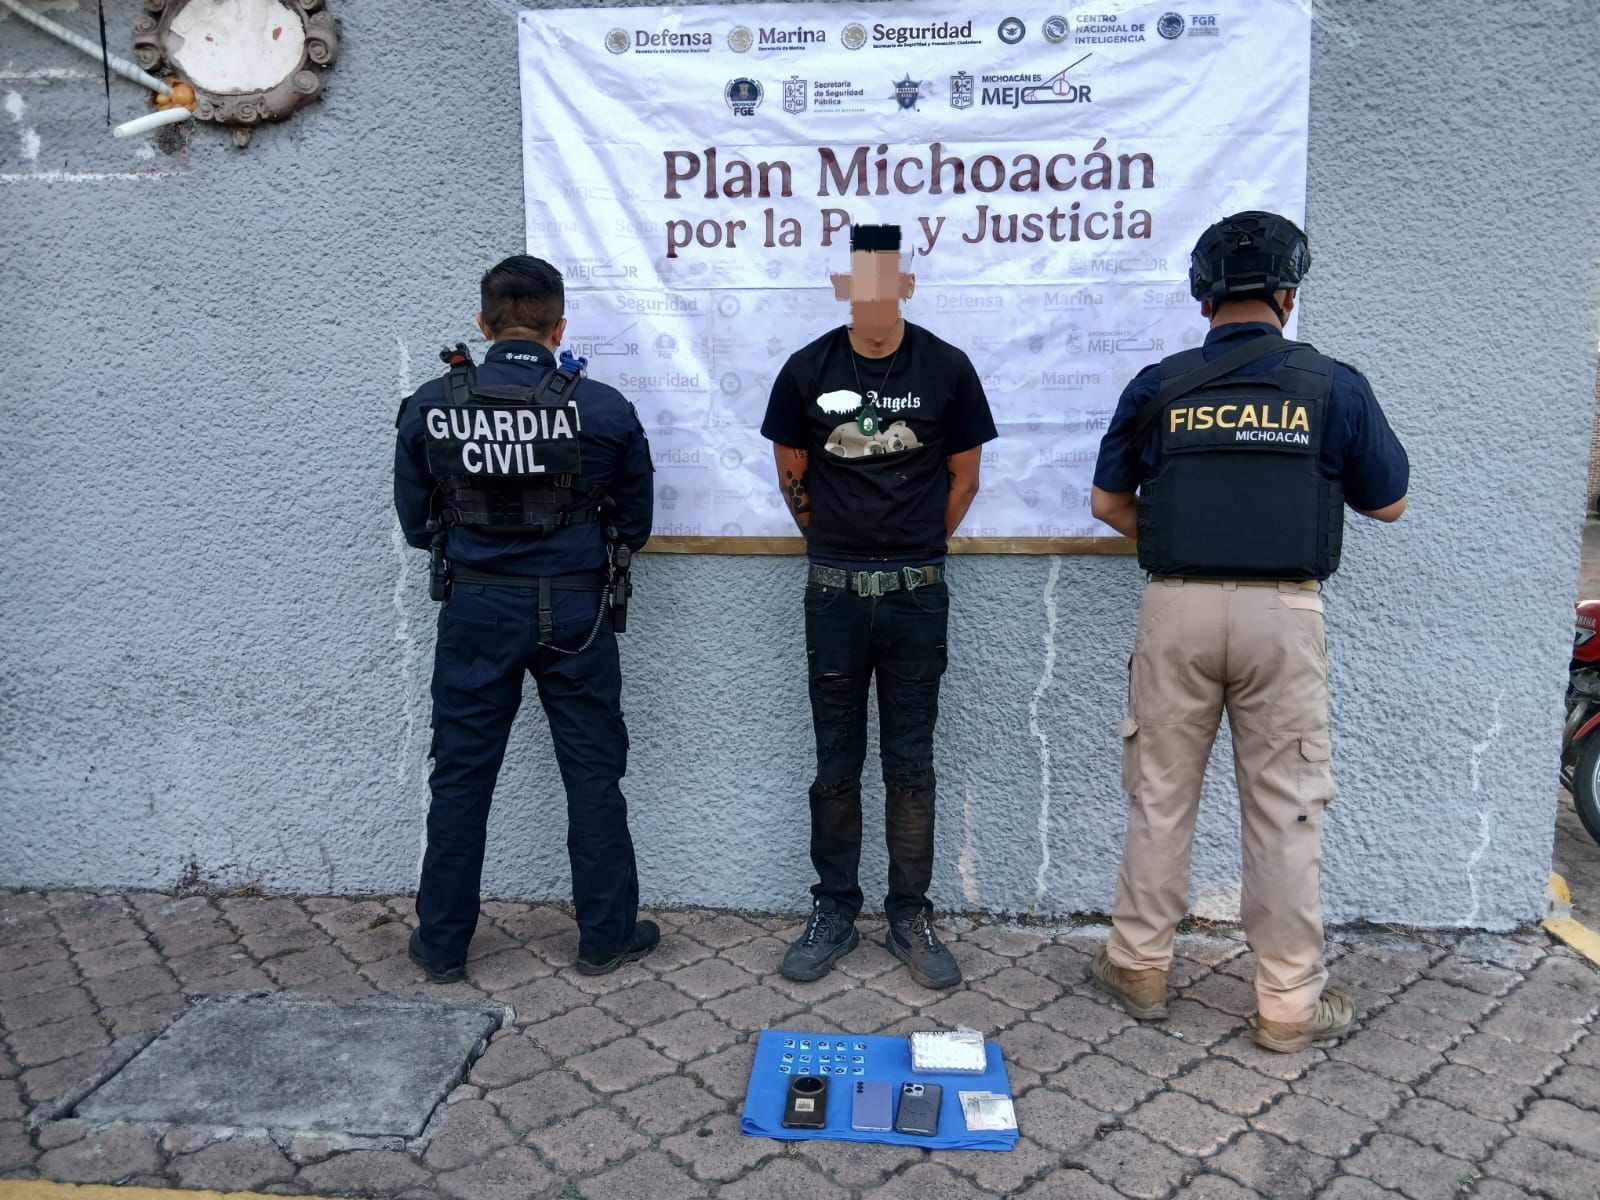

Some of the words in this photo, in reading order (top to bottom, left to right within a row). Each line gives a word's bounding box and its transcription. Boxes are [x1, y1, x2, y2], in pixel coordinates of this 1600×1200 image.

[1076, 14, 1117, 23] CENTRO
[1191, 15, 1216, 26] FGR
[635, 28, 712, 47] Defensa
[758, 26, 826, 44] Marina
[872, 20, 972, 43] Seguridad
[1075, 24, 1128, 34] NACIONAL
[1131, 24, 1145, 32] DE
[1074, 34, 1146, 44] INTELIGENCIA
[980, 73, 1032, 83] MICHOACÁN
[1032, 74, 1043, 82] ES
[825, 88, 865, 98] Seguridad
[733, 106, 756, 116] FGE
[664, 147, 793, 199] Plan
[817, 137, 1155, 197] Michoacán
[665, 219, 747, 259] por
[763, 208, 802, 248] la
[917, 216, 946, 256] y
[961, 200, 1154, 244] Justicia
[616, 295, 698, 313] Seguridad
[618, 371, 700, 389] Seguridad
[1041, 370, 1101, 386] Marina
[866, 390, 921, 412] Angels
[426, 408, 573, 442] GUARDIA
[1169, 400, 1310, 433] FISCALÍA
[1235, 430, 1309, 445] MICHOACÁN
[461, 442, 546, 474] CIVIL
